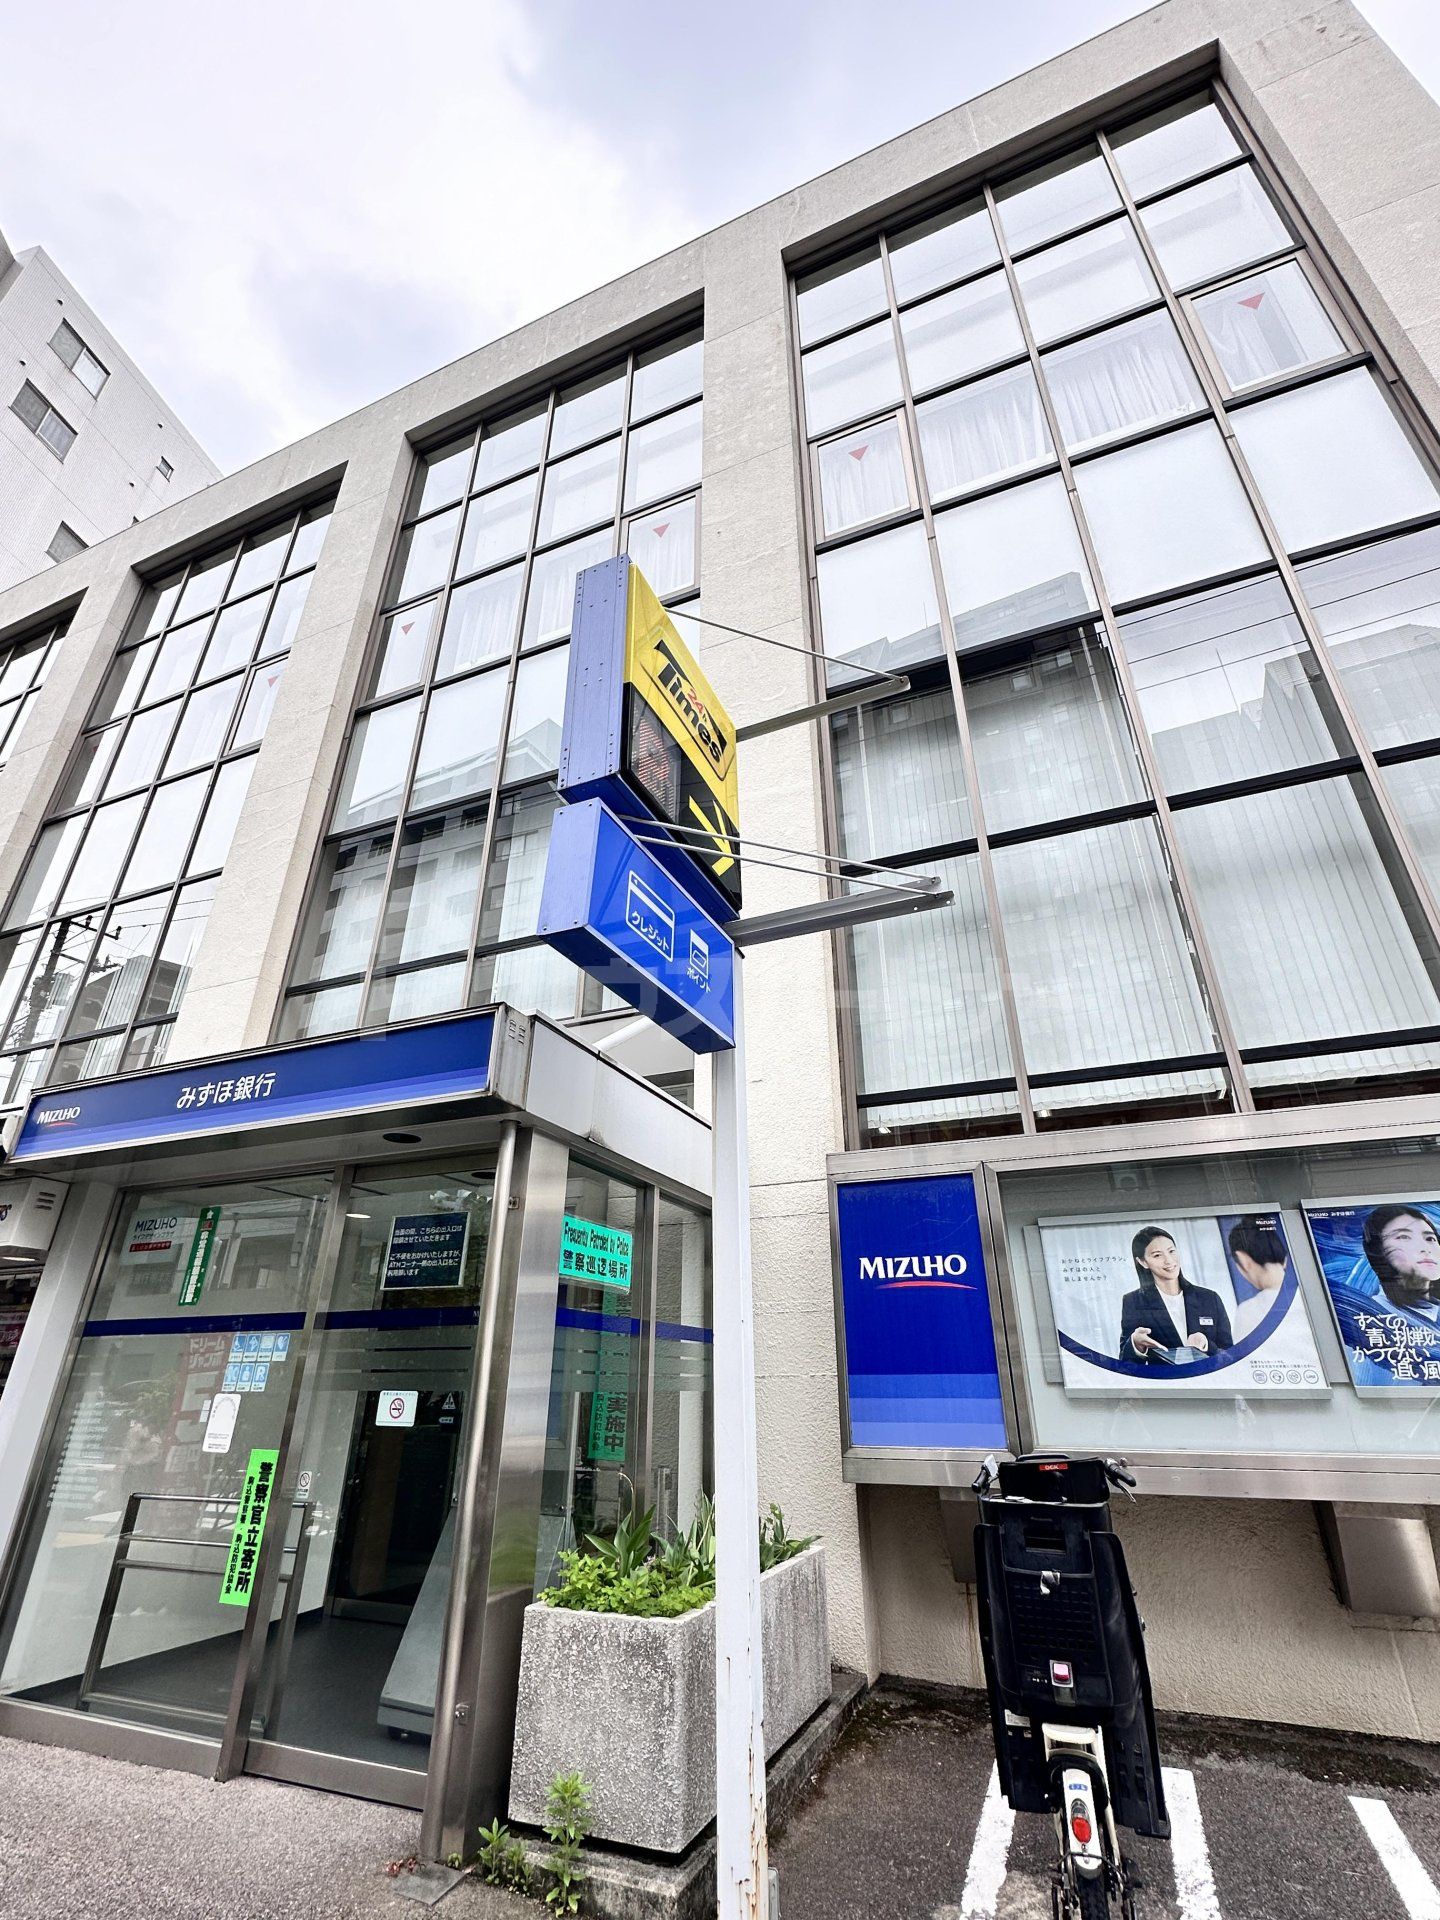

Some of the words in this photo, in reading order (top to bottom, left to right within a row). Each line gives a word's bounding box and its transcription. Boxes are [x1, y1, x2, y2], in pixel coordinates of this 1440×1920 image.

[654, 638, 728, 763] Times
[631, 910, 670, 951] クレジット
[686, 966, 711, 993] ポイント
[176, 1072, 277, 1109] みずほ銀行
[36, 1106, 81, 1125] MIZUHO
[134, 1216, 178, 1232] MIZUHO
[858, 1254, 968, 1280] MIZUHO
[1353, 1312, 1407, 1330] すべての
[1365, 1326, 1436, 1347] 青い挑戦
[1352, 1346, 1431, 1366] かつてない
[234, 1461, 274, 1594] 警察官立寄所
